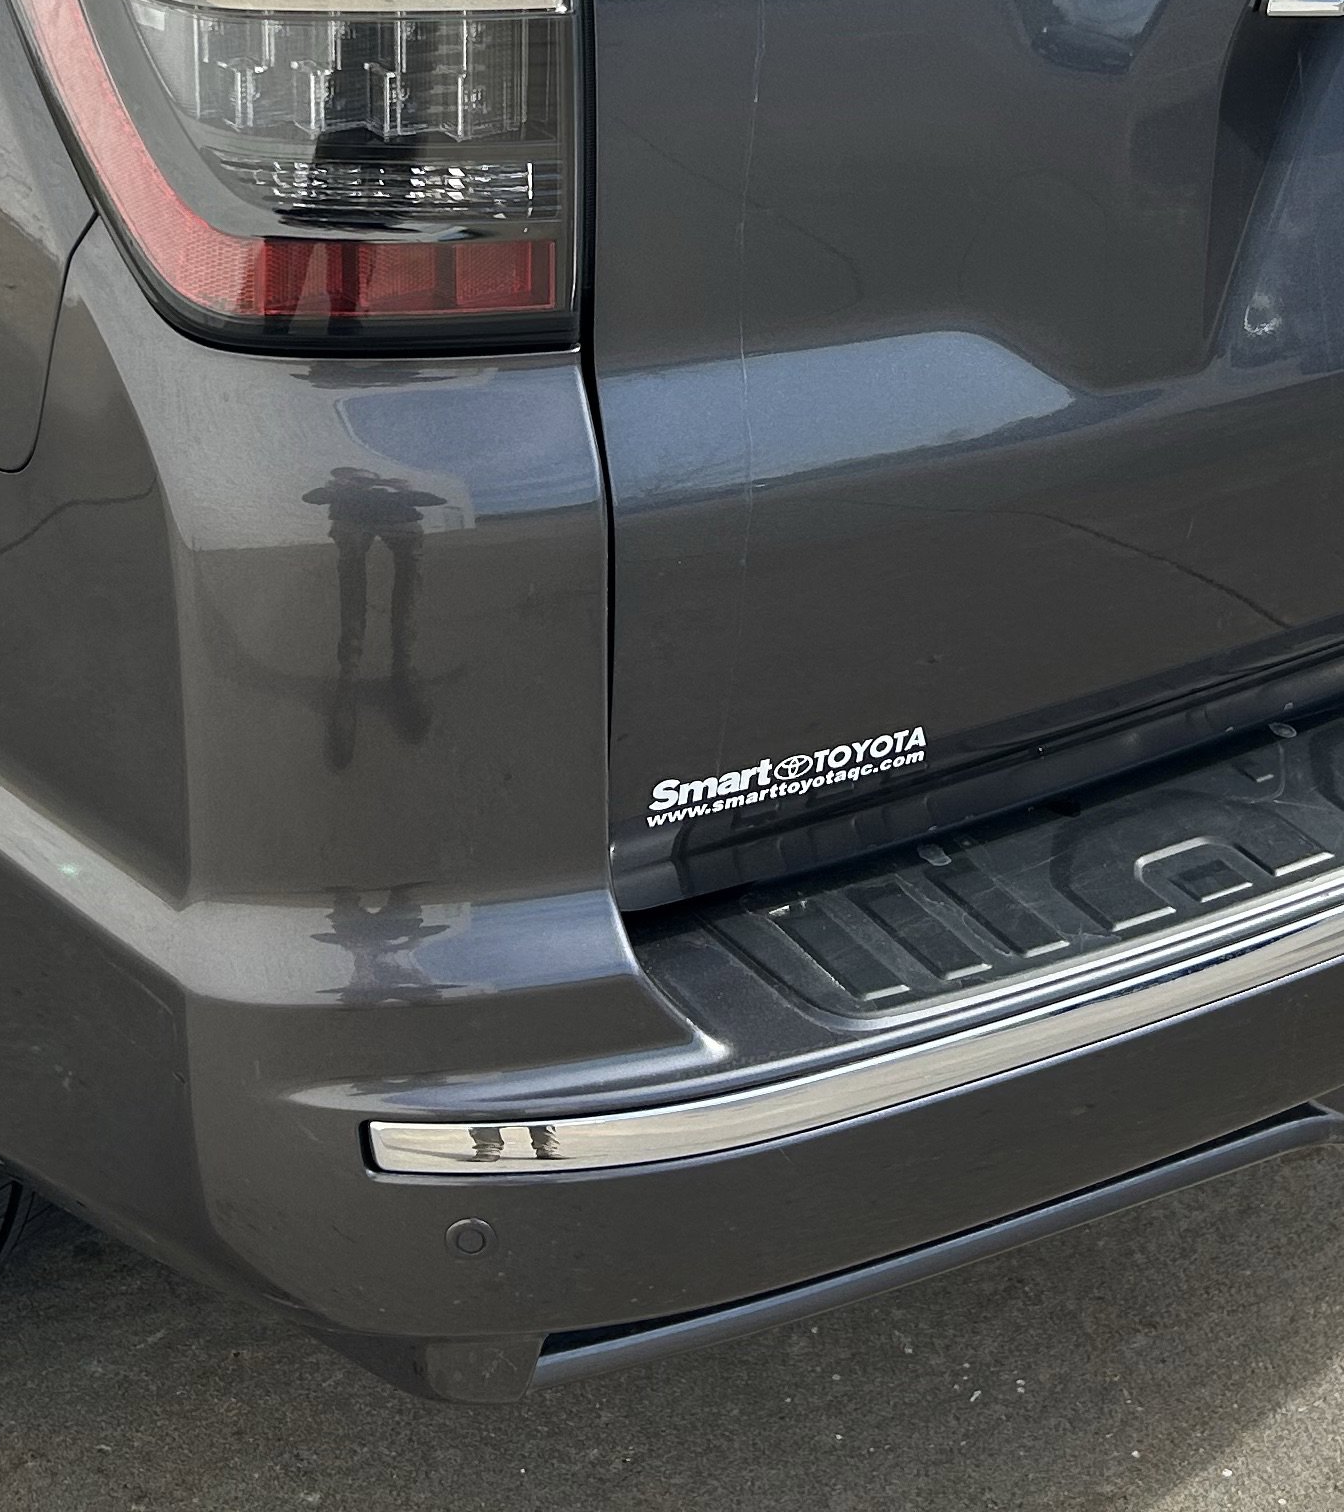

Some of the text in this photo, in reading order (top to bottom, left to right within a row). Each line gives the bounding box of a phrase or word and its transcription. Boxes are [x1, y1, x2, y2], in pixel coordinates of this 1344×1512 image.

[646, 750, 926, 828] www.smarttoyotaqc.com
[648, 726, 927, 811] Smart TOYOTA
